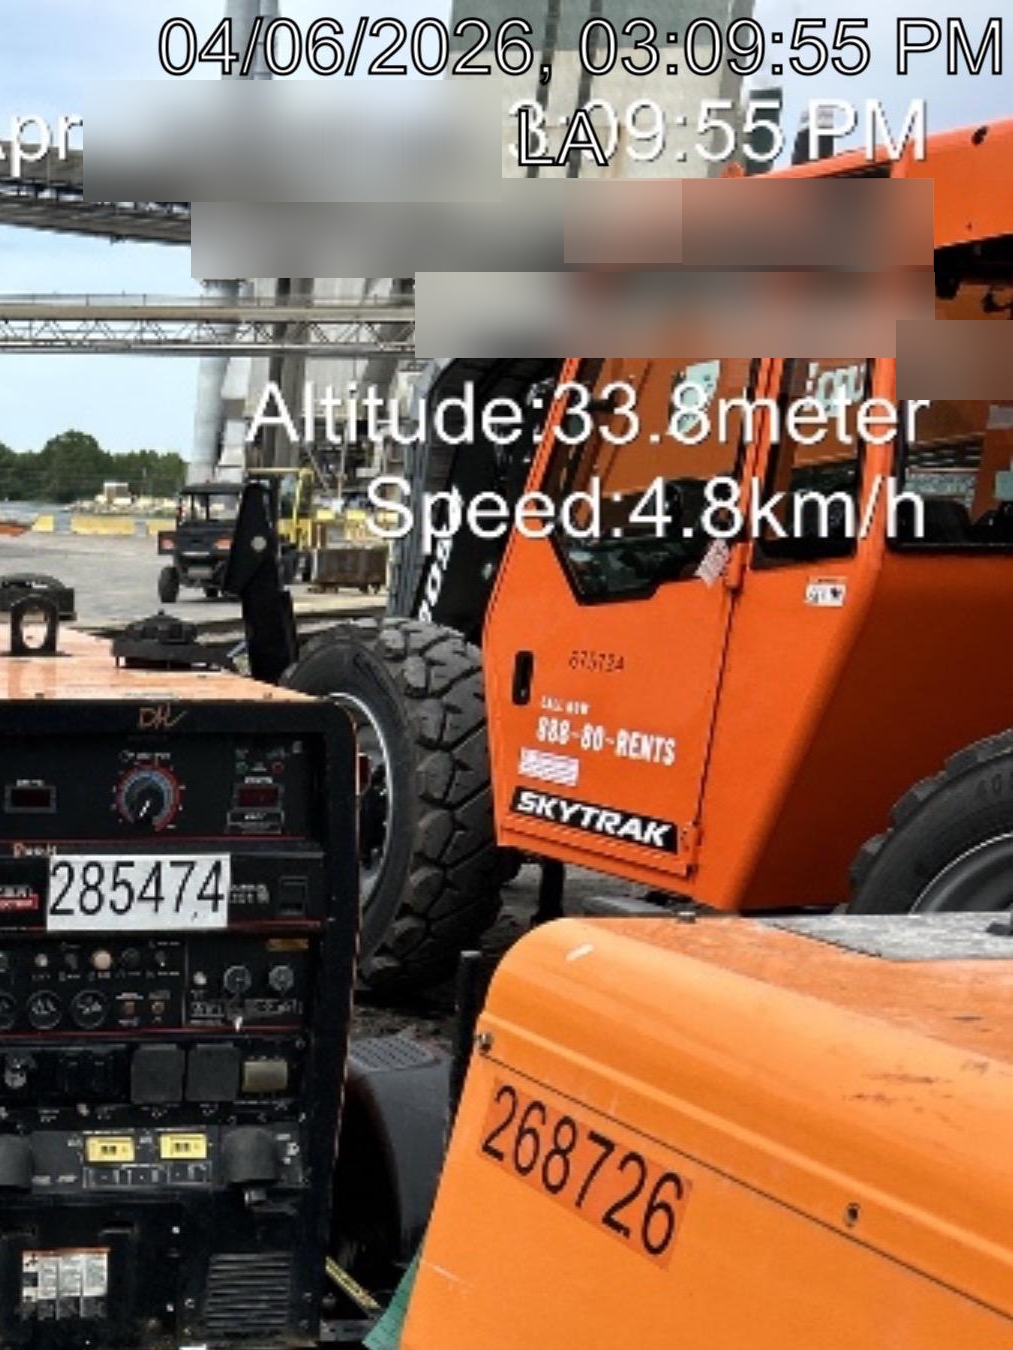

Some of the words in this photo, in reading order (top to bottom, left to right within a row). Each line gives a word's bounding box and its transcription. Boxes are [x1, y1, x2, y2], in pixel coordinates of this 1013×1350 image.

[536, 716, 676, 767] 888-80-RENTS
[517, 790, 672, 847] SKYTRAK
[49, 859, 225, 916] 285474
[482, 1085, 684, 1256] 268726
